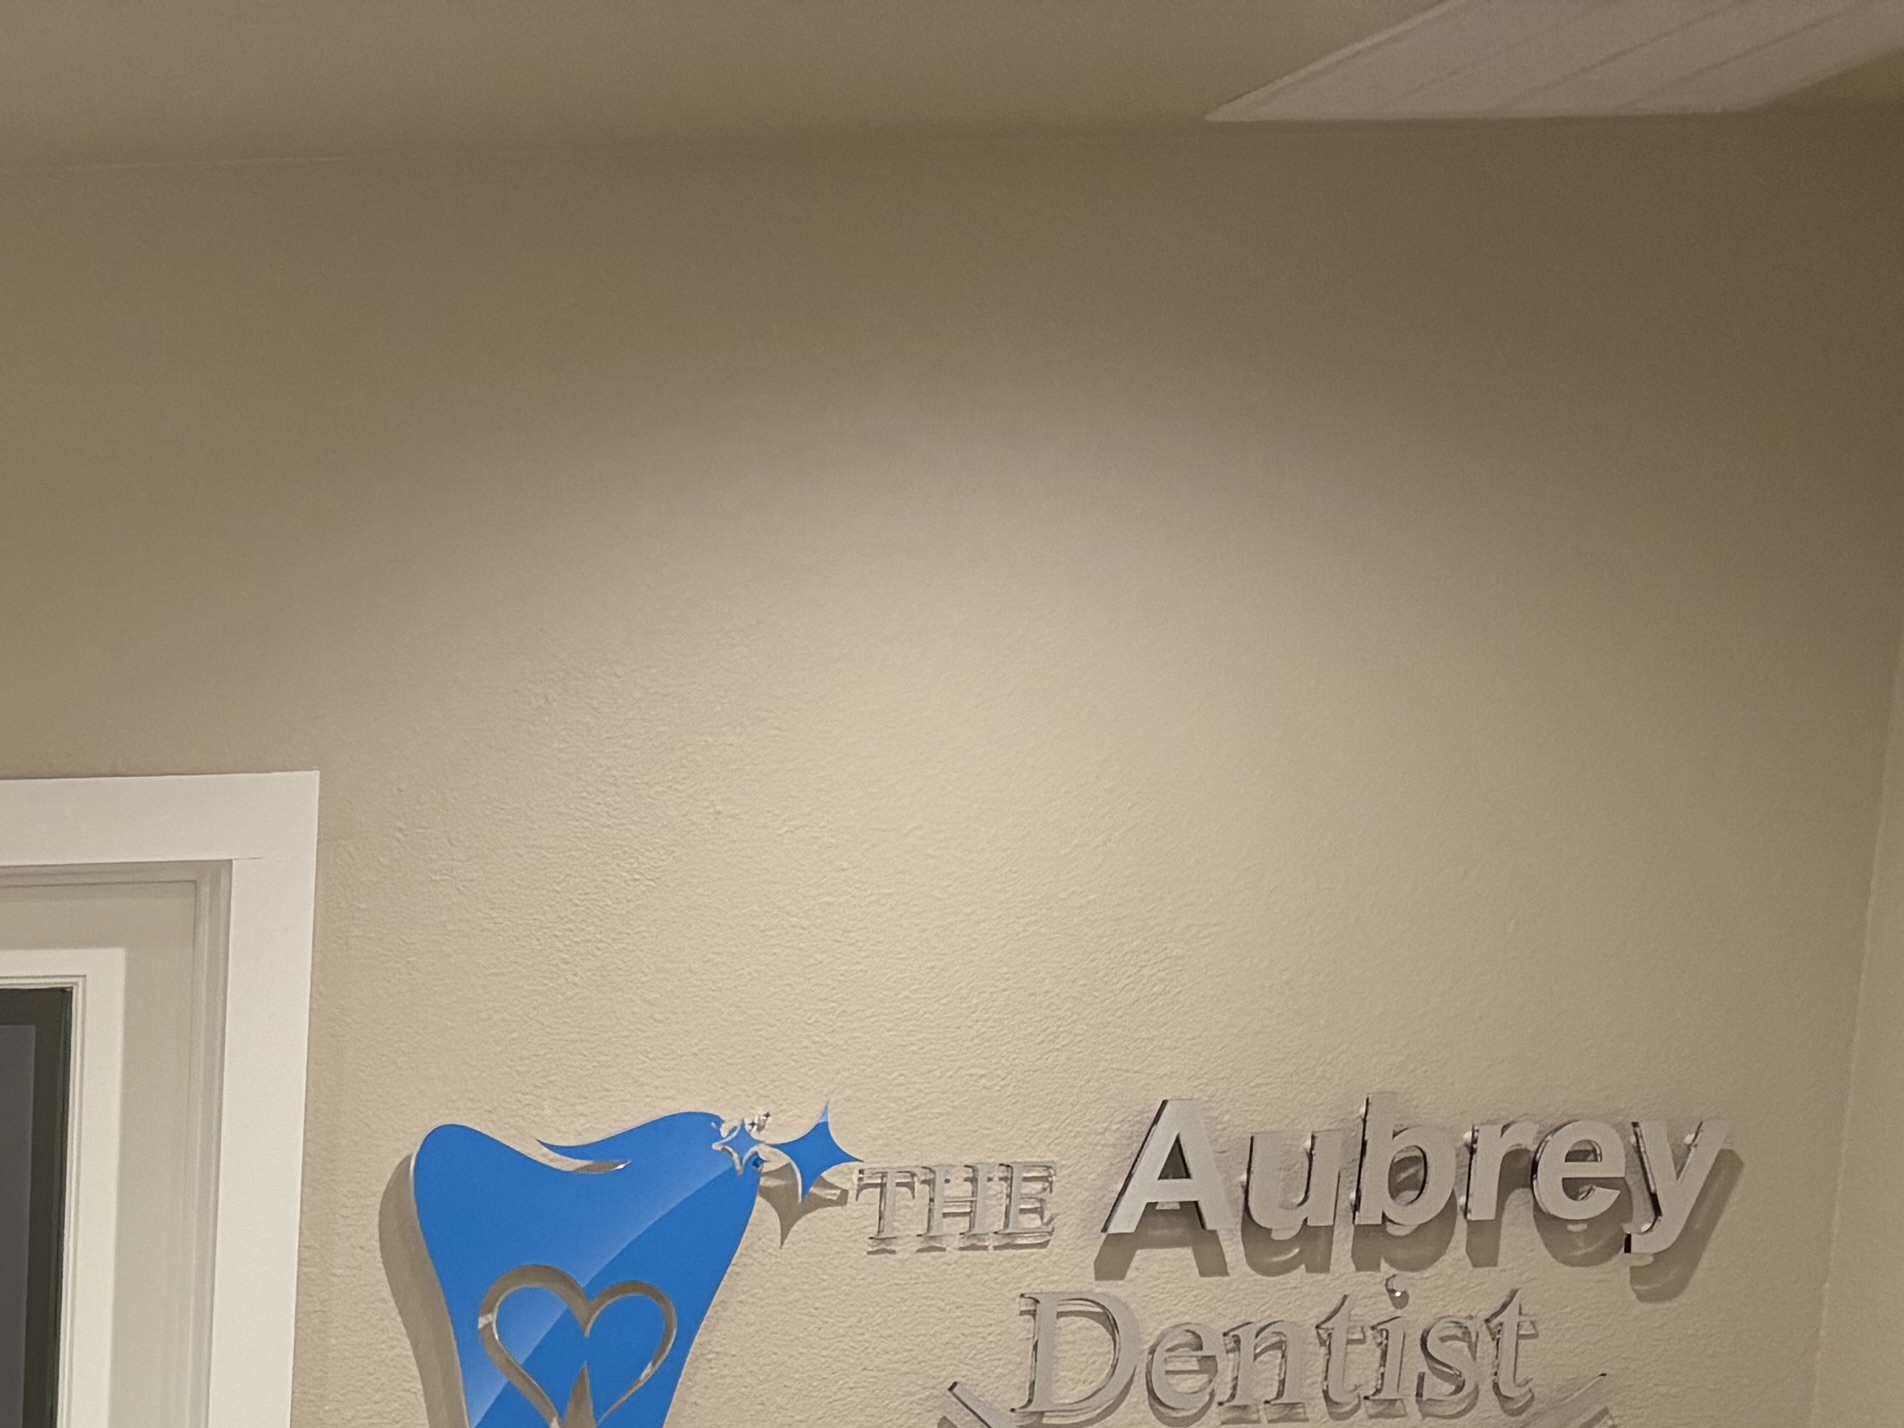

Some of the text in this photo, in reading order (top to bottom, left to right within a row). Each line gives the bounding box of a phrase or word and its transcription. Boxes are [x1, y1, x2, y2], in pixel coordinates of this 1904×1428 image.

[857, 1093, 1731, 1256] THE Aubrey
[1010, 1276, 1540, 1420] Dentist
